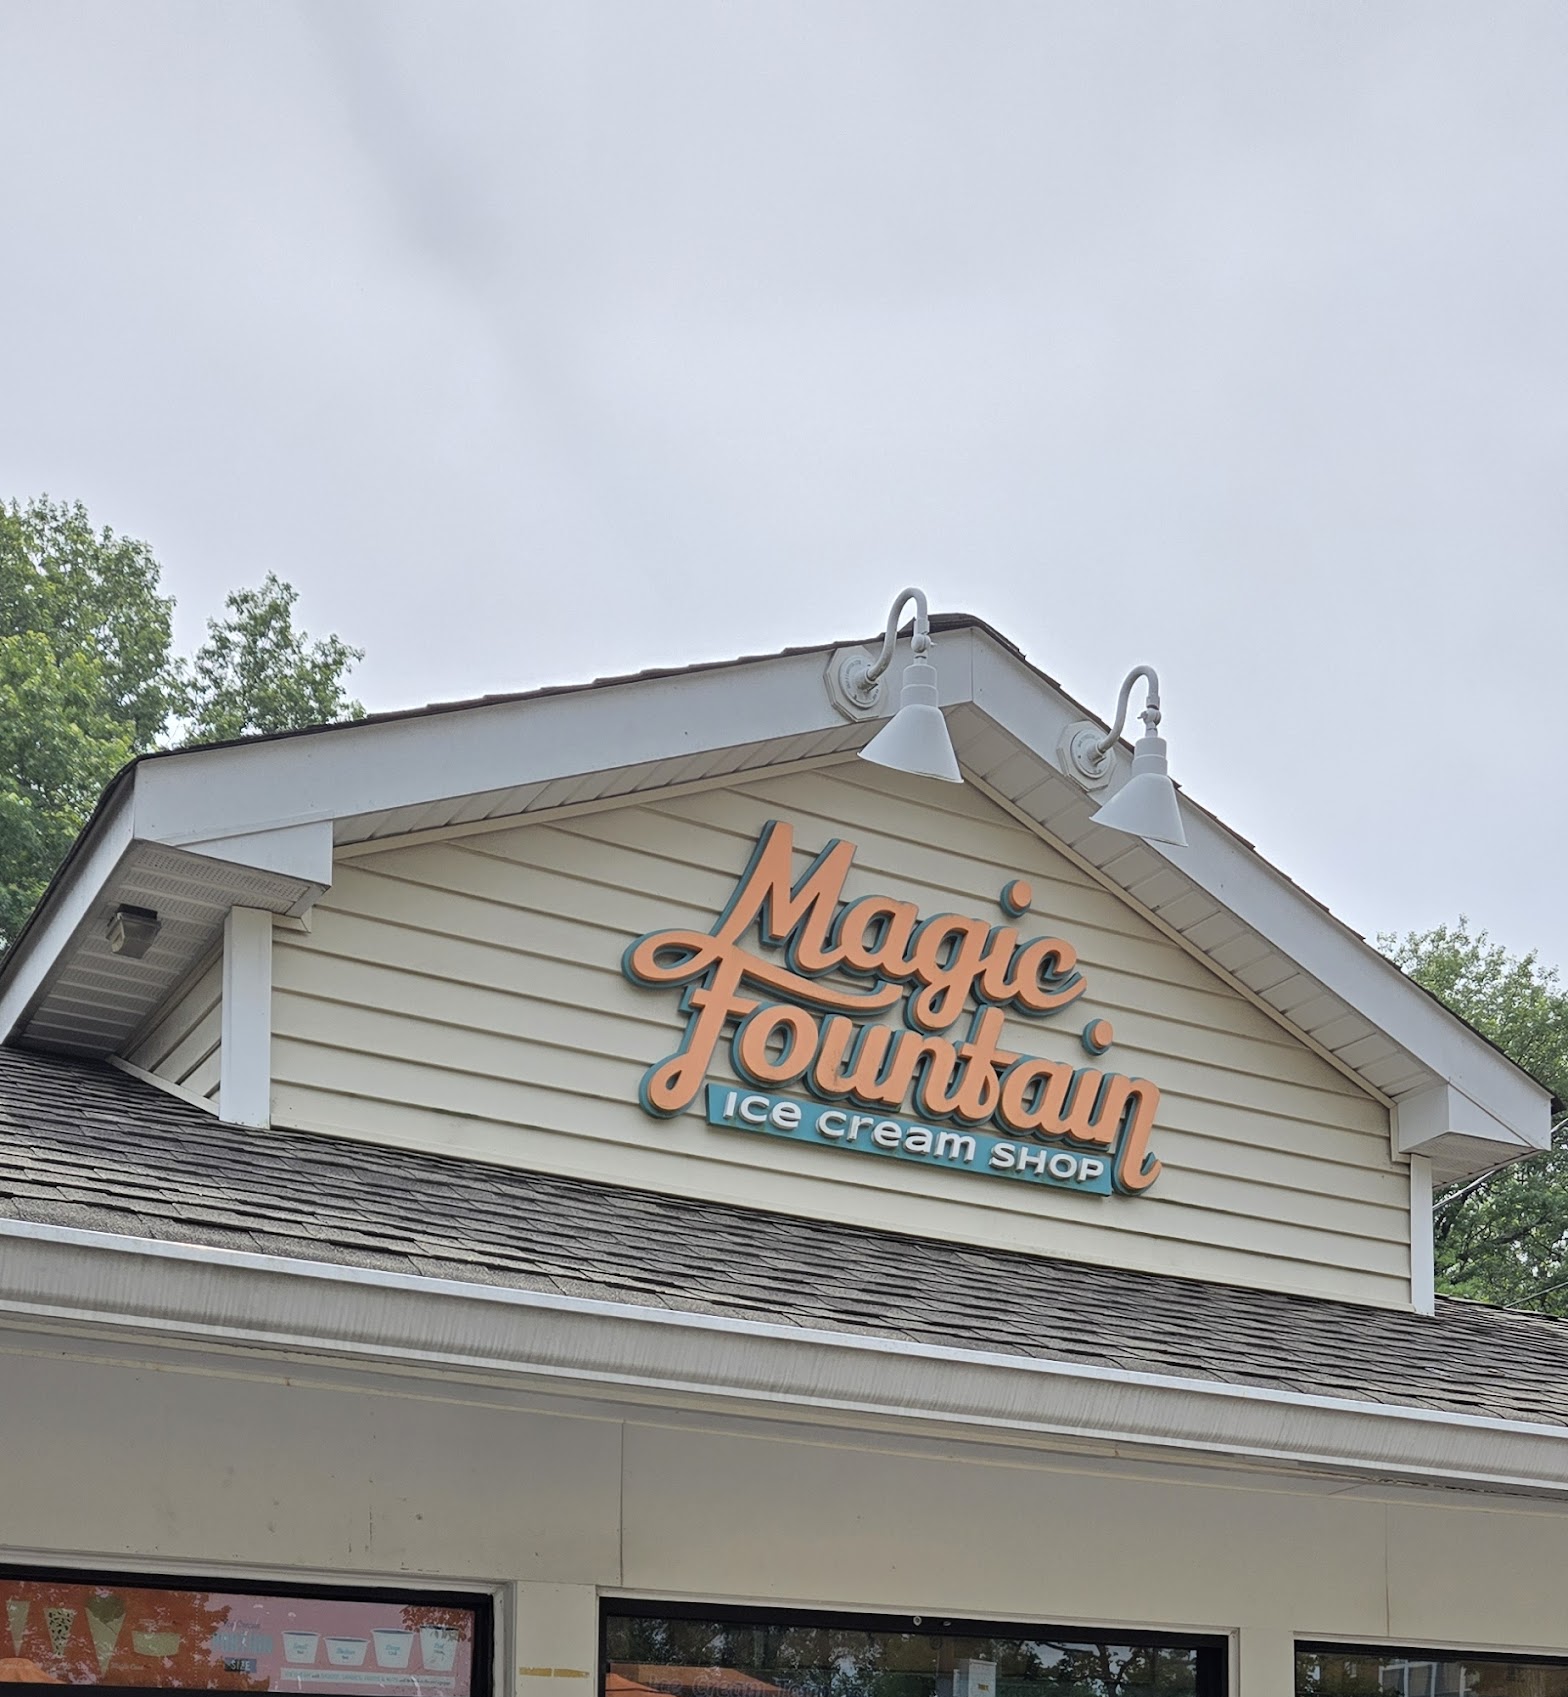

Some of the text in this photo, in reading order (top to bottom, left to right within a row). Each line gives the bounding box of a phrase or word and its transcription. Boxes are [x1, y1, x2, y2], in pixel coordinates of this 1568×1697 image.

[622, 820, 1088, 1030] Magic
[640, 945, 1162, 1196] Fountain
[988, 1144, 1105, 1183] SHOP
